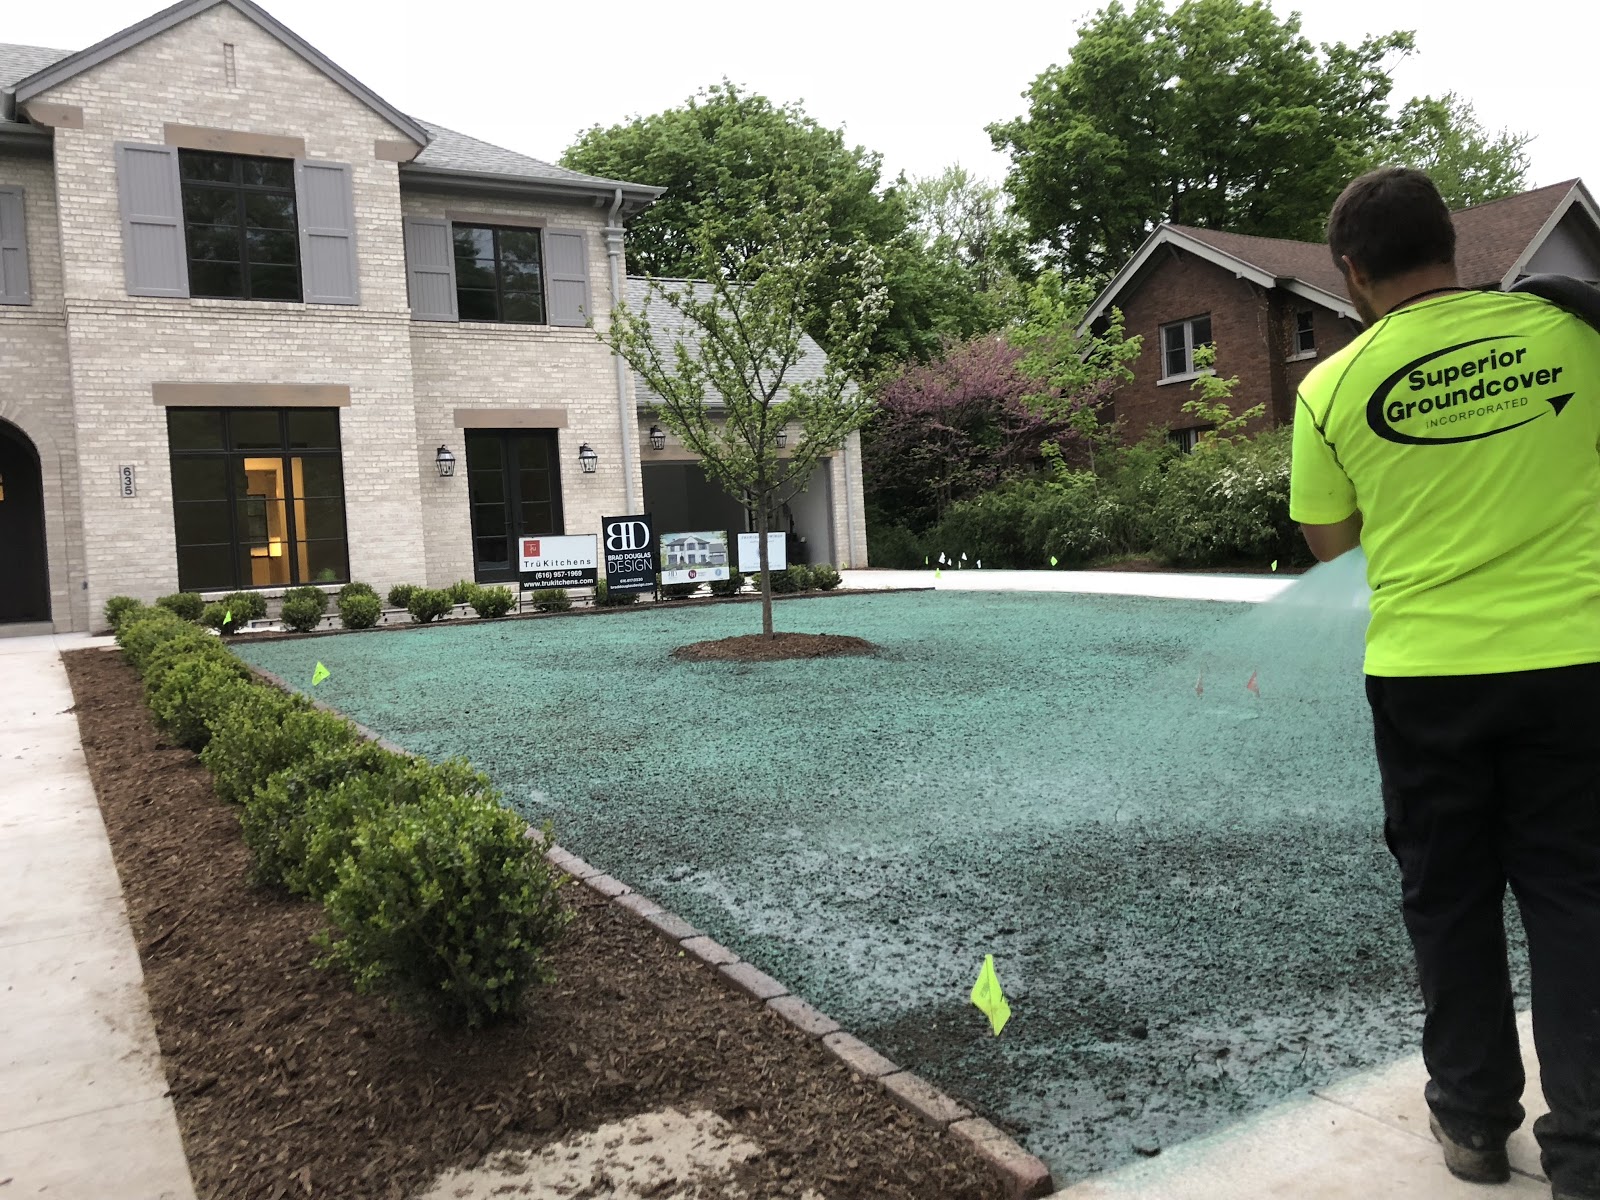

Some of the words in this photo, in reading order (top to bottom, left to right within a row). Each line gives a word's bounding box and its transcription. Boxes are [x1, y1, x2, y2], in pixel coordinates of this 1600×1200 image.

[1409, 347, 1527, 391] Superior
[1386, 366, 1563, 423] Groundcover
[1426, 397, 1528, 429] INCORPORATED
[123, 467, 133, 495] 635
[608, 559, 653, 574] DESIGN
[624, 552, 652, 560] DOUGLAS
[524, 578, 593, 588] www.trukitchens.com
[535, 572, 552, 580] (616)
[553, 570, 582, 578] 957-1969
